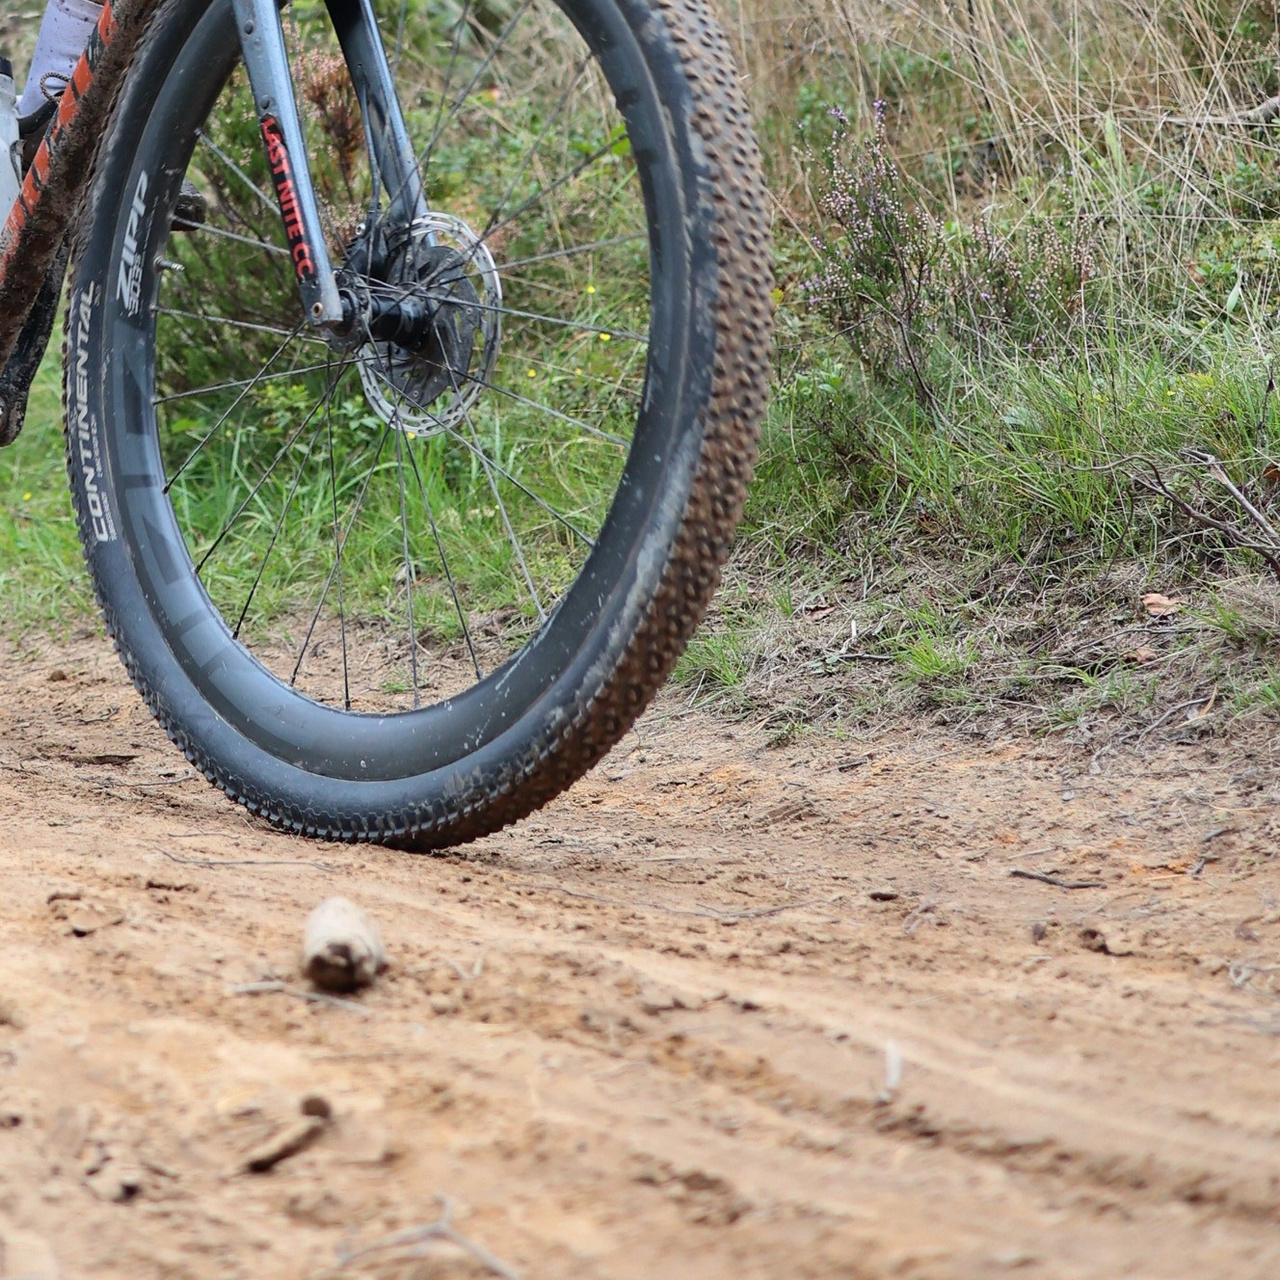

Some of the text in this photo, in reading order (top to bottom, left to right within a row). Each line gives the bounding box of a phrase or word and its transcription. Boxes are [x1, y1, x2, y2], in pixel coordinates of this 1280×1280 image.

[116, 169, 149, 308] ZIPP
[261, 115, 315, 278] LAST NITE CC
[76, 280, 109, 542] CONTINENTAL
